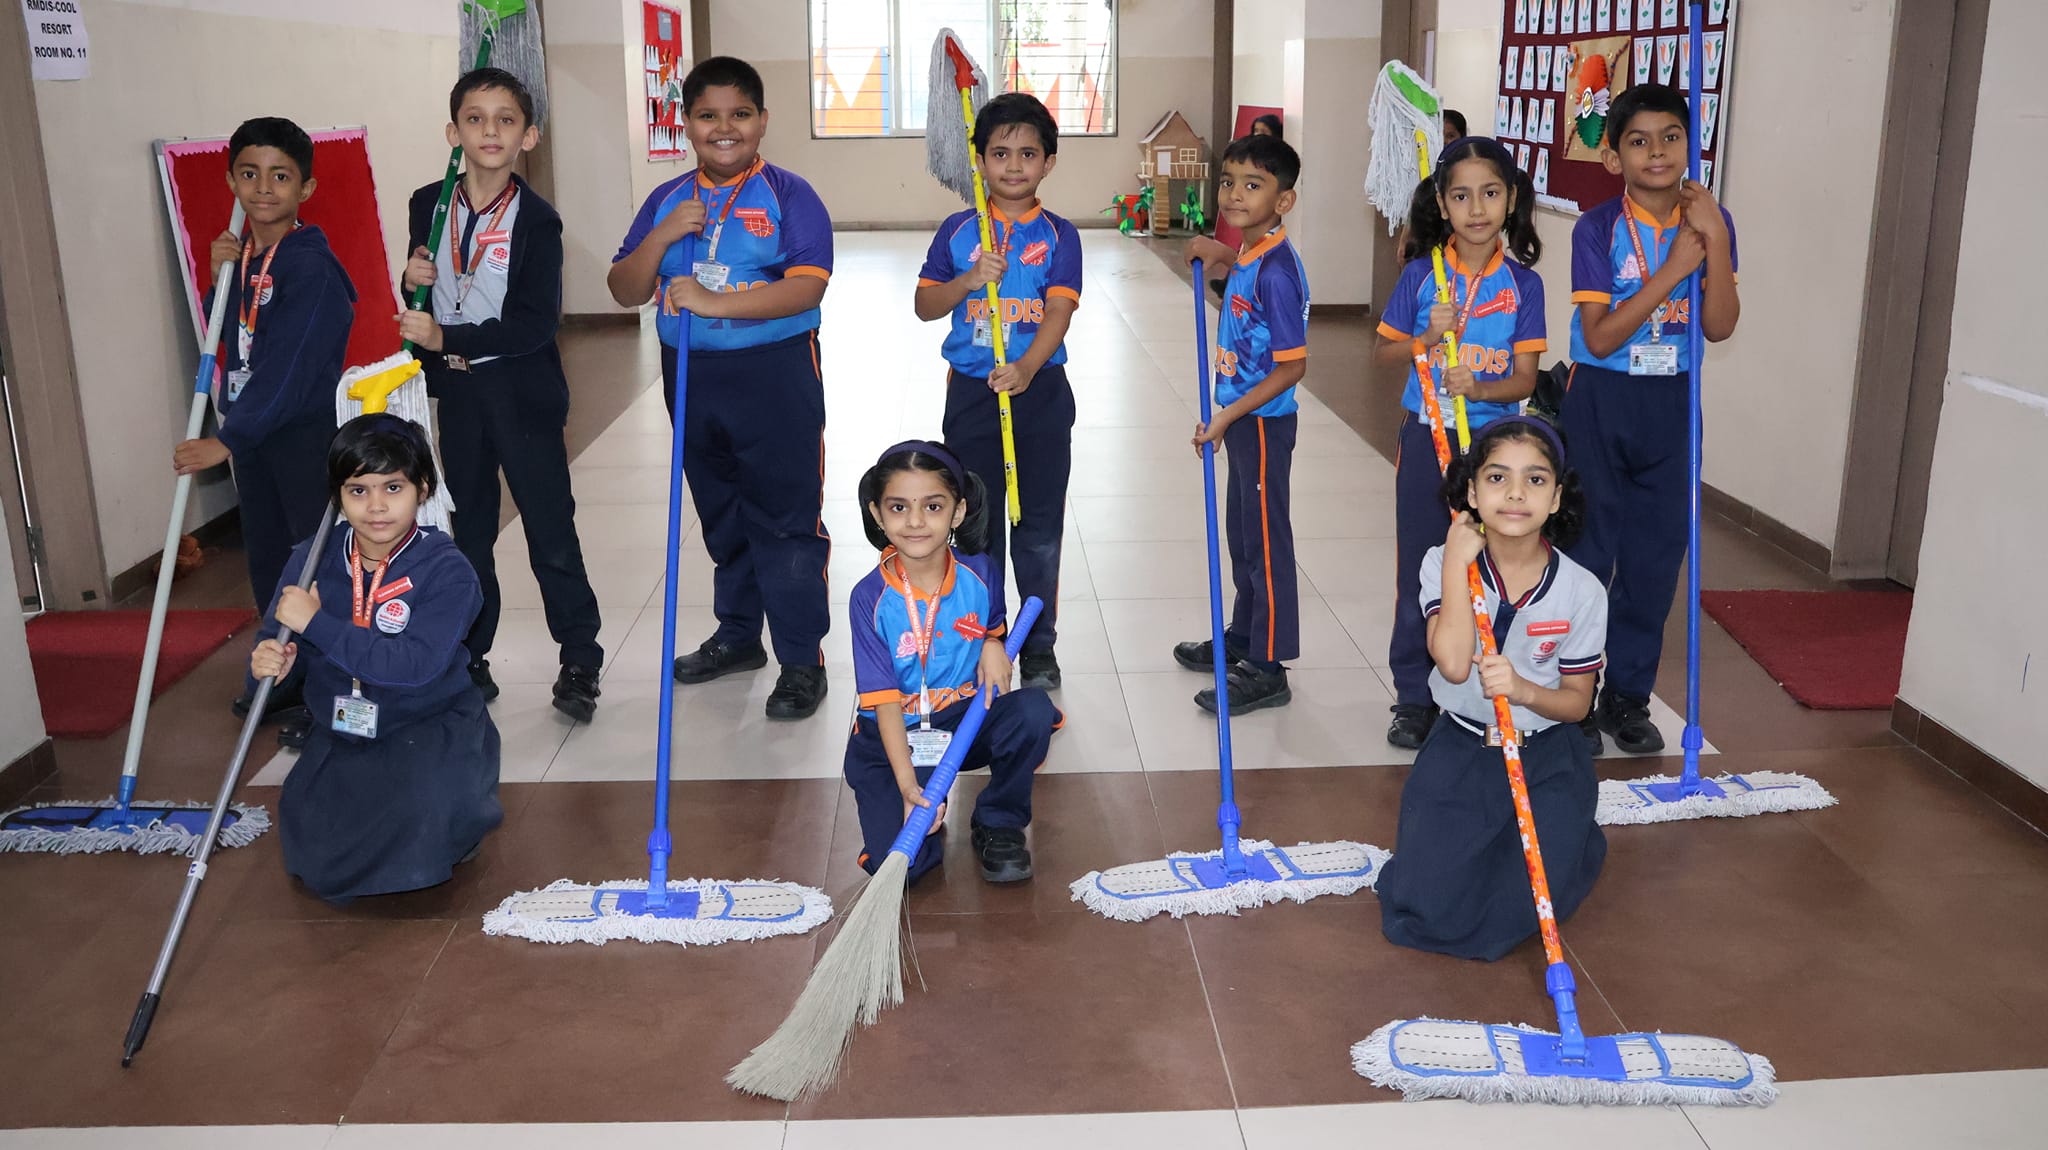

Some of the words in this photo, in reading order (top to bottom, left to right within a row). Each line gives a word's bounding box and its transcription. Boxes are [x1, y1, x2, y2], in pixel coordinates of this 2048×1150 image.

[41, 23, 72, 34] RESORT
[34, 46, 59, 58] ROOM
[60, 47, 75, 58] NO.
[77, 47, 87, 58] 11
[1628, 218, 1642, 256] INTERNATIONAL
[353, 554, 362, 598] INTERNATIONAL
[901, 571, 911, 594] SCHOOL
[909, 594, 920, 637] INTERNATIONAL
[925, 595, 937, 637] INTERNATIONAL
